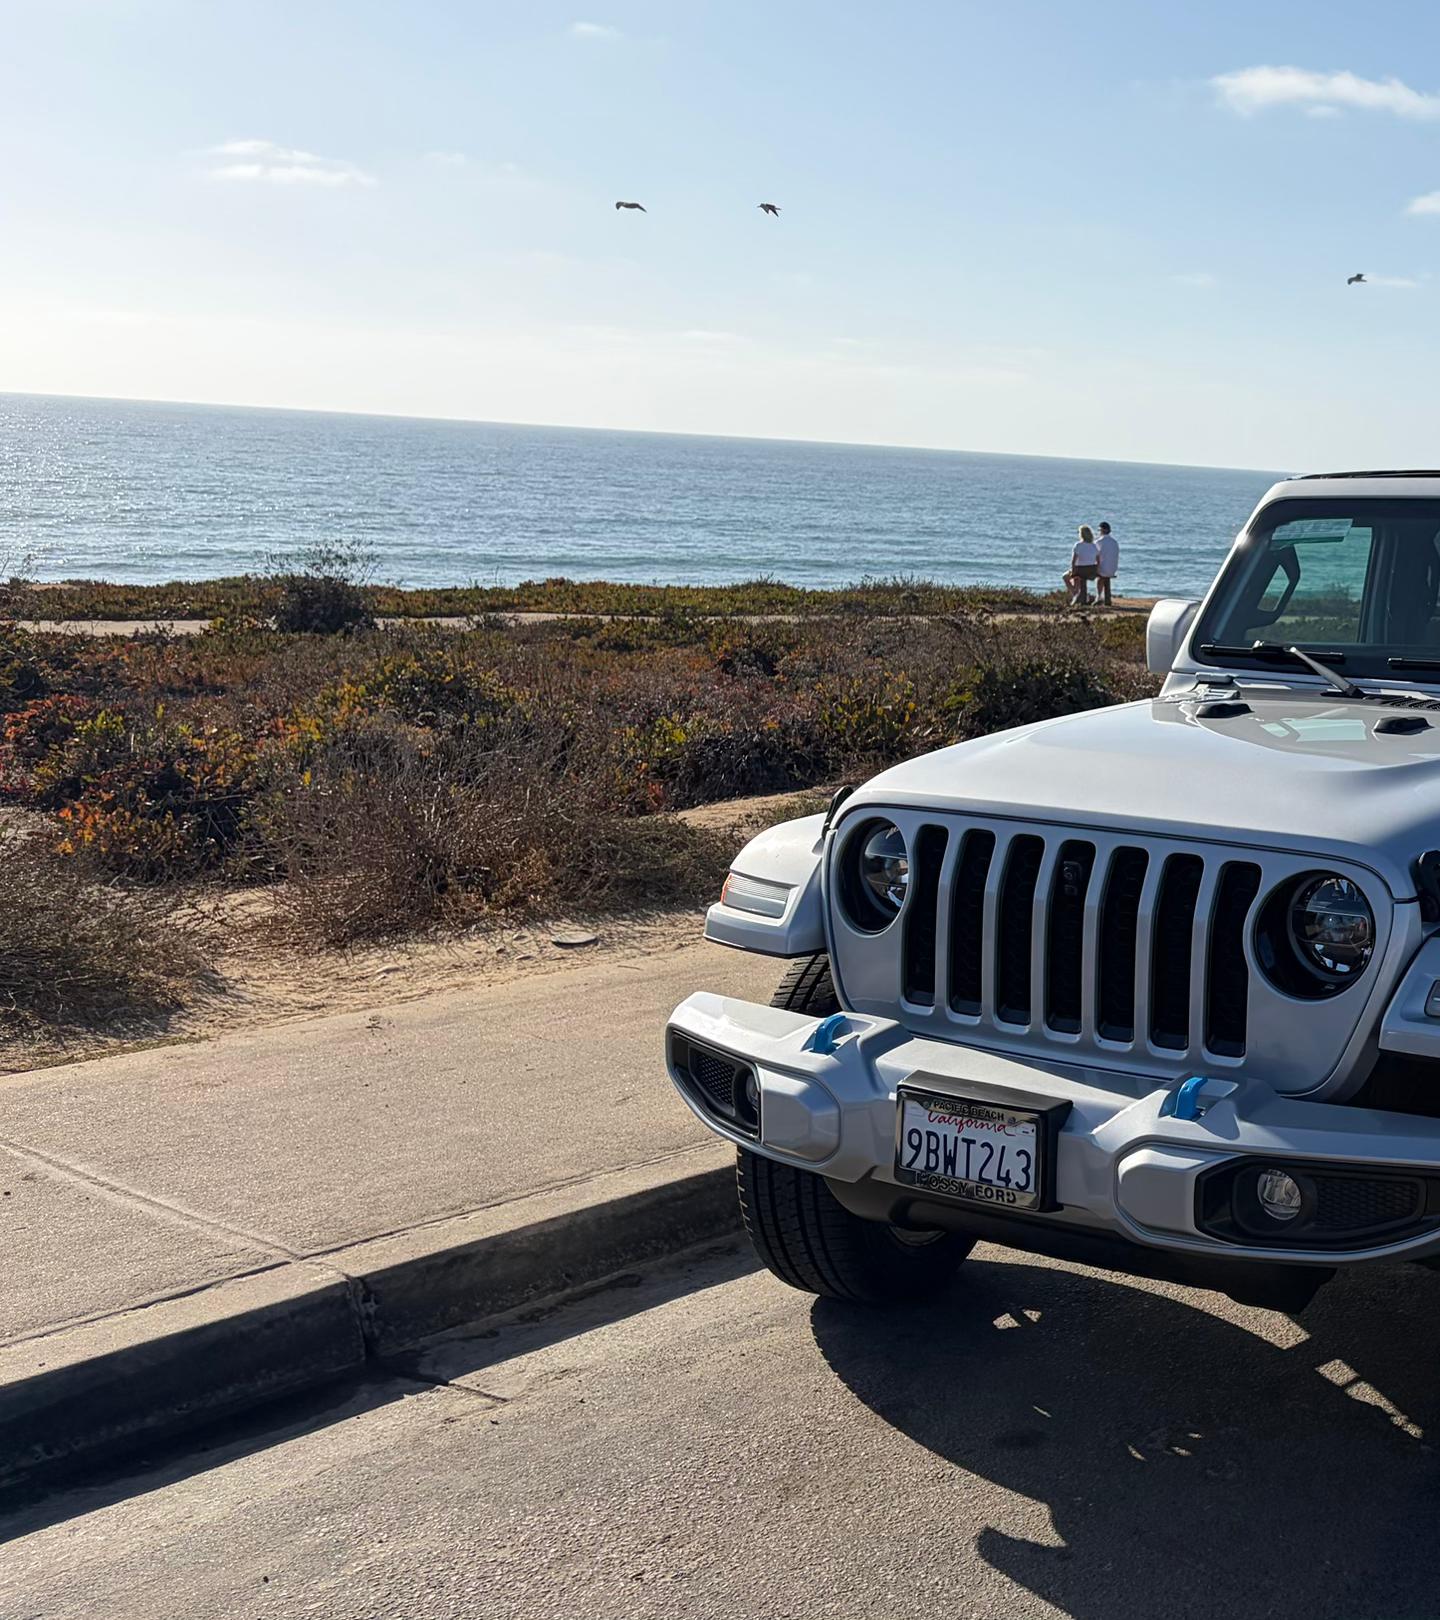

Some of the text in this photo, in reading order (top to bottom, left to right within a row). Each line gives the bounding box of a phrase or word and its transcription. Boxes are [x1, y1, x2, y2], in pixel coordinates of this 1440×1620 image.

[933, 1100, 1005, 1122] PACIFIC BEACH
[927, 1111, 1016, 1137] California
[905, 1128, 1032, 1191] 9BWT243
[975, 1185, 1017, 1204] FORD
